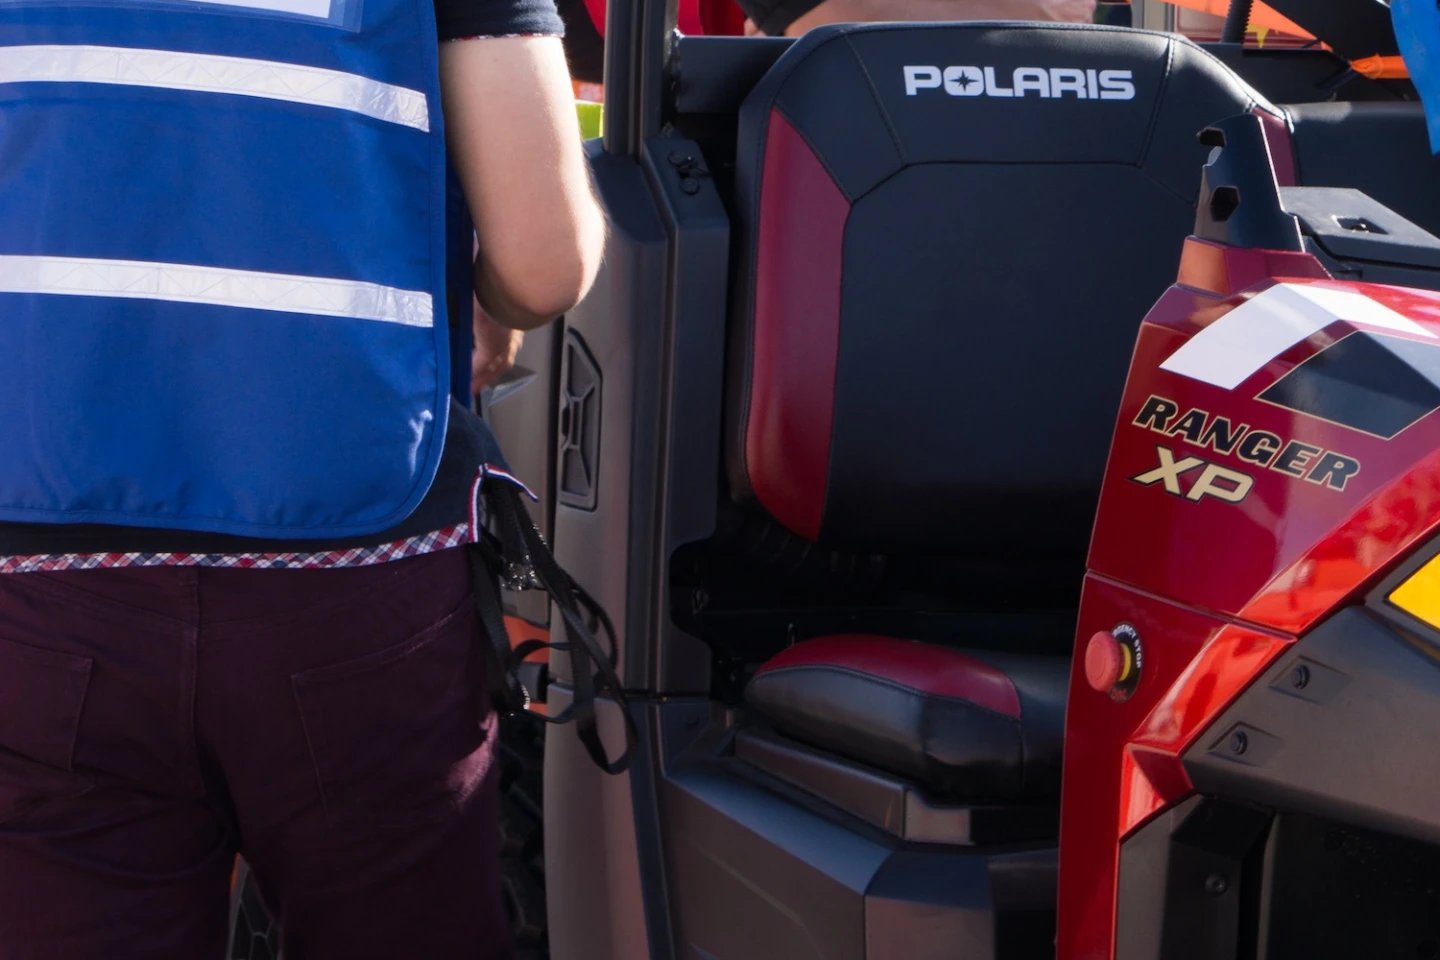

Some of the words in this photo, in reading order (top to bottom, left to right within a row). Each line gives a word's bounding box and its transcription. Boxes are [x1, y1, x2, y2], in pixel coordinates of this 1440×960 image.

[903, 65, 1136, 101] POLARIS
[1127, 443, 1256, 505] XP
[1131, 393, 1362, 493] RANGER
